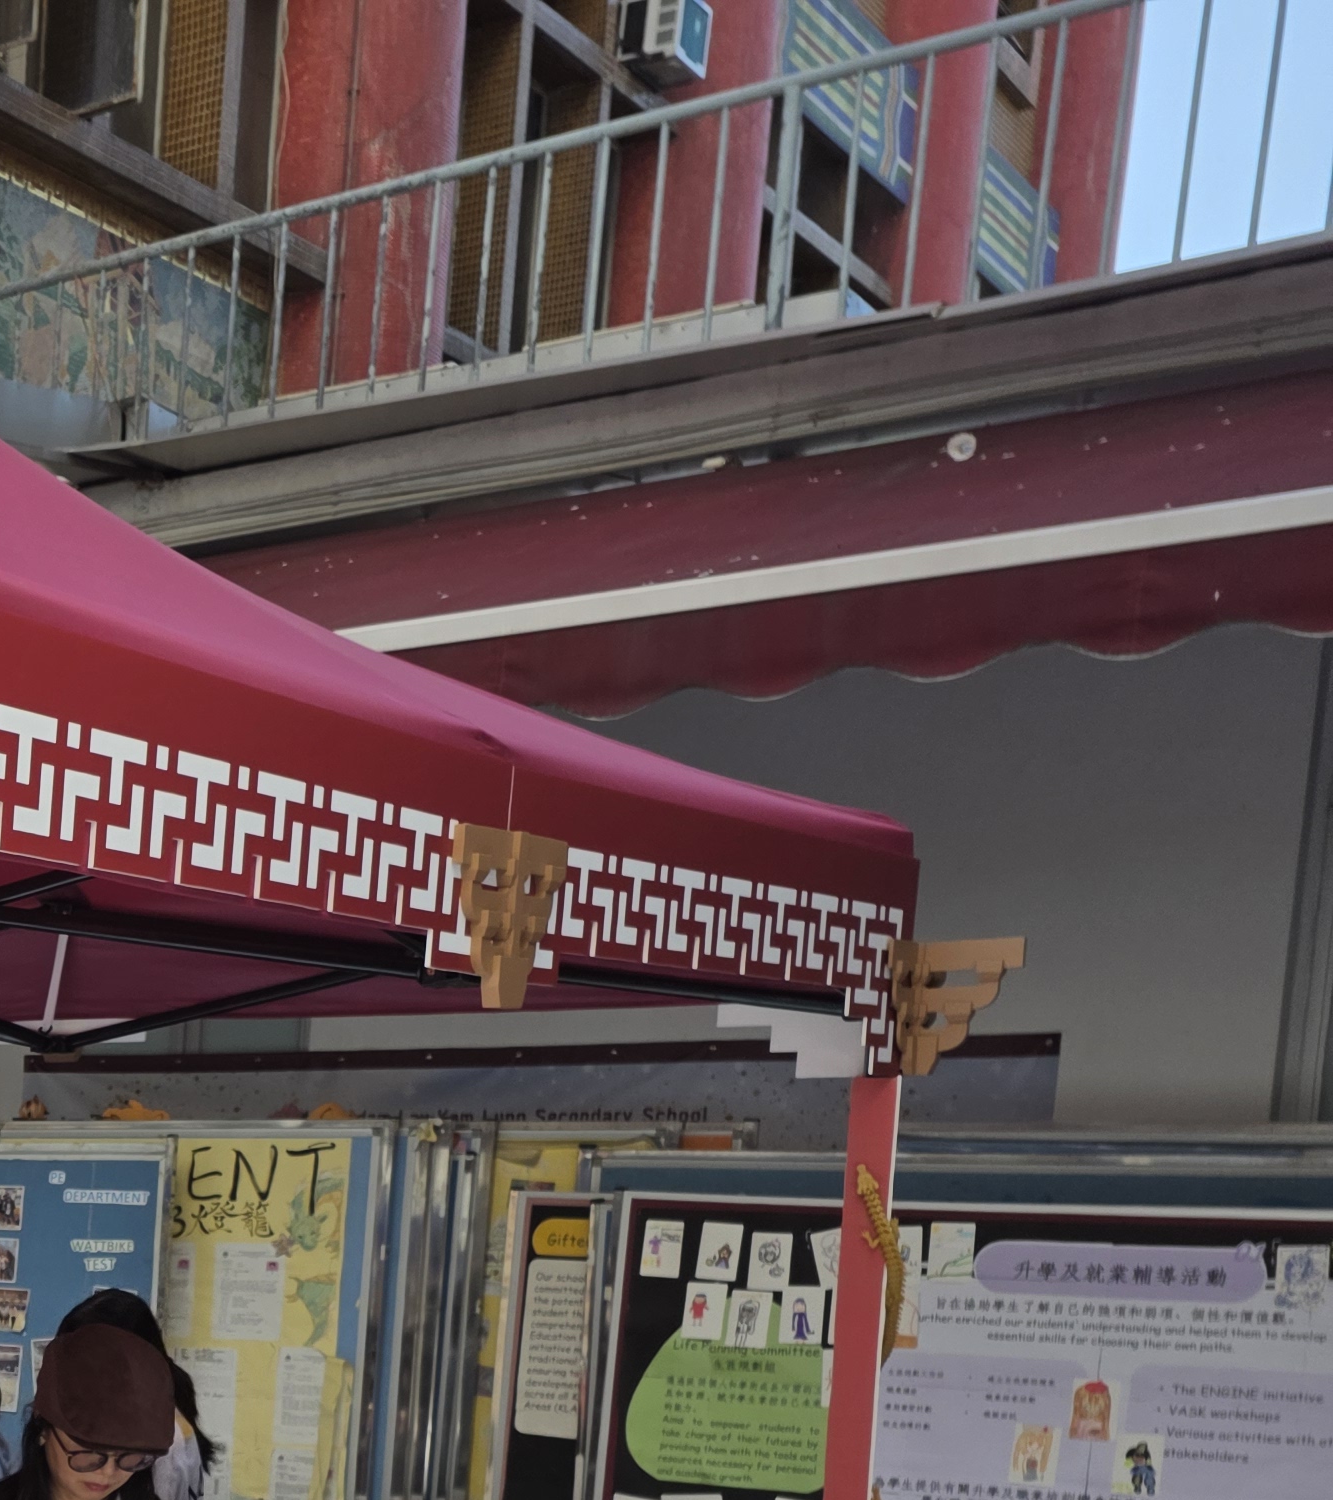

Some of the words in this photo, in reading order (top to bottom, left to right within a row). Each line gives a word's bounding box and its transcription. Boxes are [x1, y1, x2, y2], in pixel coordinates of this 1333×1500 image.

[643, 1107, 709, 1123] School
[50, 1172, 64, 1183] PE
[187, 1142, 336, 1217] ENT
[64, 1191, 148, 1204] DEPARTMENT
[71, 1241, 133, 1252] WATTBIKE
[85, 1258, 115, 1270] TEST
[535, 1272, 553, 1281] Our
[1014, 1259, 1227, 1287] 升學及就業輔導活動
[534, 1296, 549, 1305] the
[552, 1297, 584, 1307] potent
[532, 1309, 569, 1318] student
[919, 1313, 953, 1325] urther
[955, 1314, 1002, 1326] enriched
[1004, 1318, 1023, 1327] our
[1082, 1320, 1161, 1337] understanding
[1165, 1325, 1186, 1336] and
[1189, 1325, 1228, 1341] helped
[1232, 1326, 1261, 1339] them
[1265, 1328, 1278, 1340] to
[1281, 1329, 1327, 1345] develop
[529, 1331, 577, 1342] Education
[987, 1331, 1035, 1343] essential
[1038, 1332, 1066, 1344] skills
[1070, 1335, 1088, 1346] for
[1091, 1336, 1139, 1350] choosing
[1143, 1338, 1171, 1350] their
[1174, 1342, 1197, 1352] own
[673, 1338, 698, 1351] Life
[524, 1379, 580, 1389] developmen
[524, 1390, 555, 1399] across
[1172, 1384, 1196, 1395] The
[1200, 1386, 1259, 1399] ENGINE
[1263, 1389, 1324, 1404] initiative
[523, 1401, 551, 1411] Areas
[554, 1402, 578, 1414] (KLA
[1169, 1405, 1207, 1418] VASK
[1210, 1409, 1281, 1425] workshops
[693, 1417, 703, 1426] to
[710, 1421, 751, 1431] empower
[759, 1422, 801, 1434] students
[810, 1425, 820, 1436] to
[661, 1429, 680, 1438] take
[685, 1430, 717, 1443] charge
[721, 1432, 732, 1442] of
[737, 1433, 760, 1444] their
[766, 1436, 803, 1448] futures
[807, 1438, 819, 1450] by
[1167, 1426, 1215, 1441] Various
[1218, 1430, 1281, 1445] activities
[1286, 1433, 1315, 1447] with
[659, 1442, 701, 1455] providing
[704, 1445, 728, 1455] them
[729, 1445, 751, 1456] with
[754, 1448, 771, 1459] the
[773, 1450, 797, 1461] tools
[799, 1452, 818, 1462] and
[1163, 1447, 1250, 1464] stakeholders
[656, 1466, 674, 1477] and
[657, 1455, 703, 1466] resources
[706, 1458, 753, 1471] necessary
[757, 1460, 772, 1472] for
[775, 1463, 817, 1475] personal
